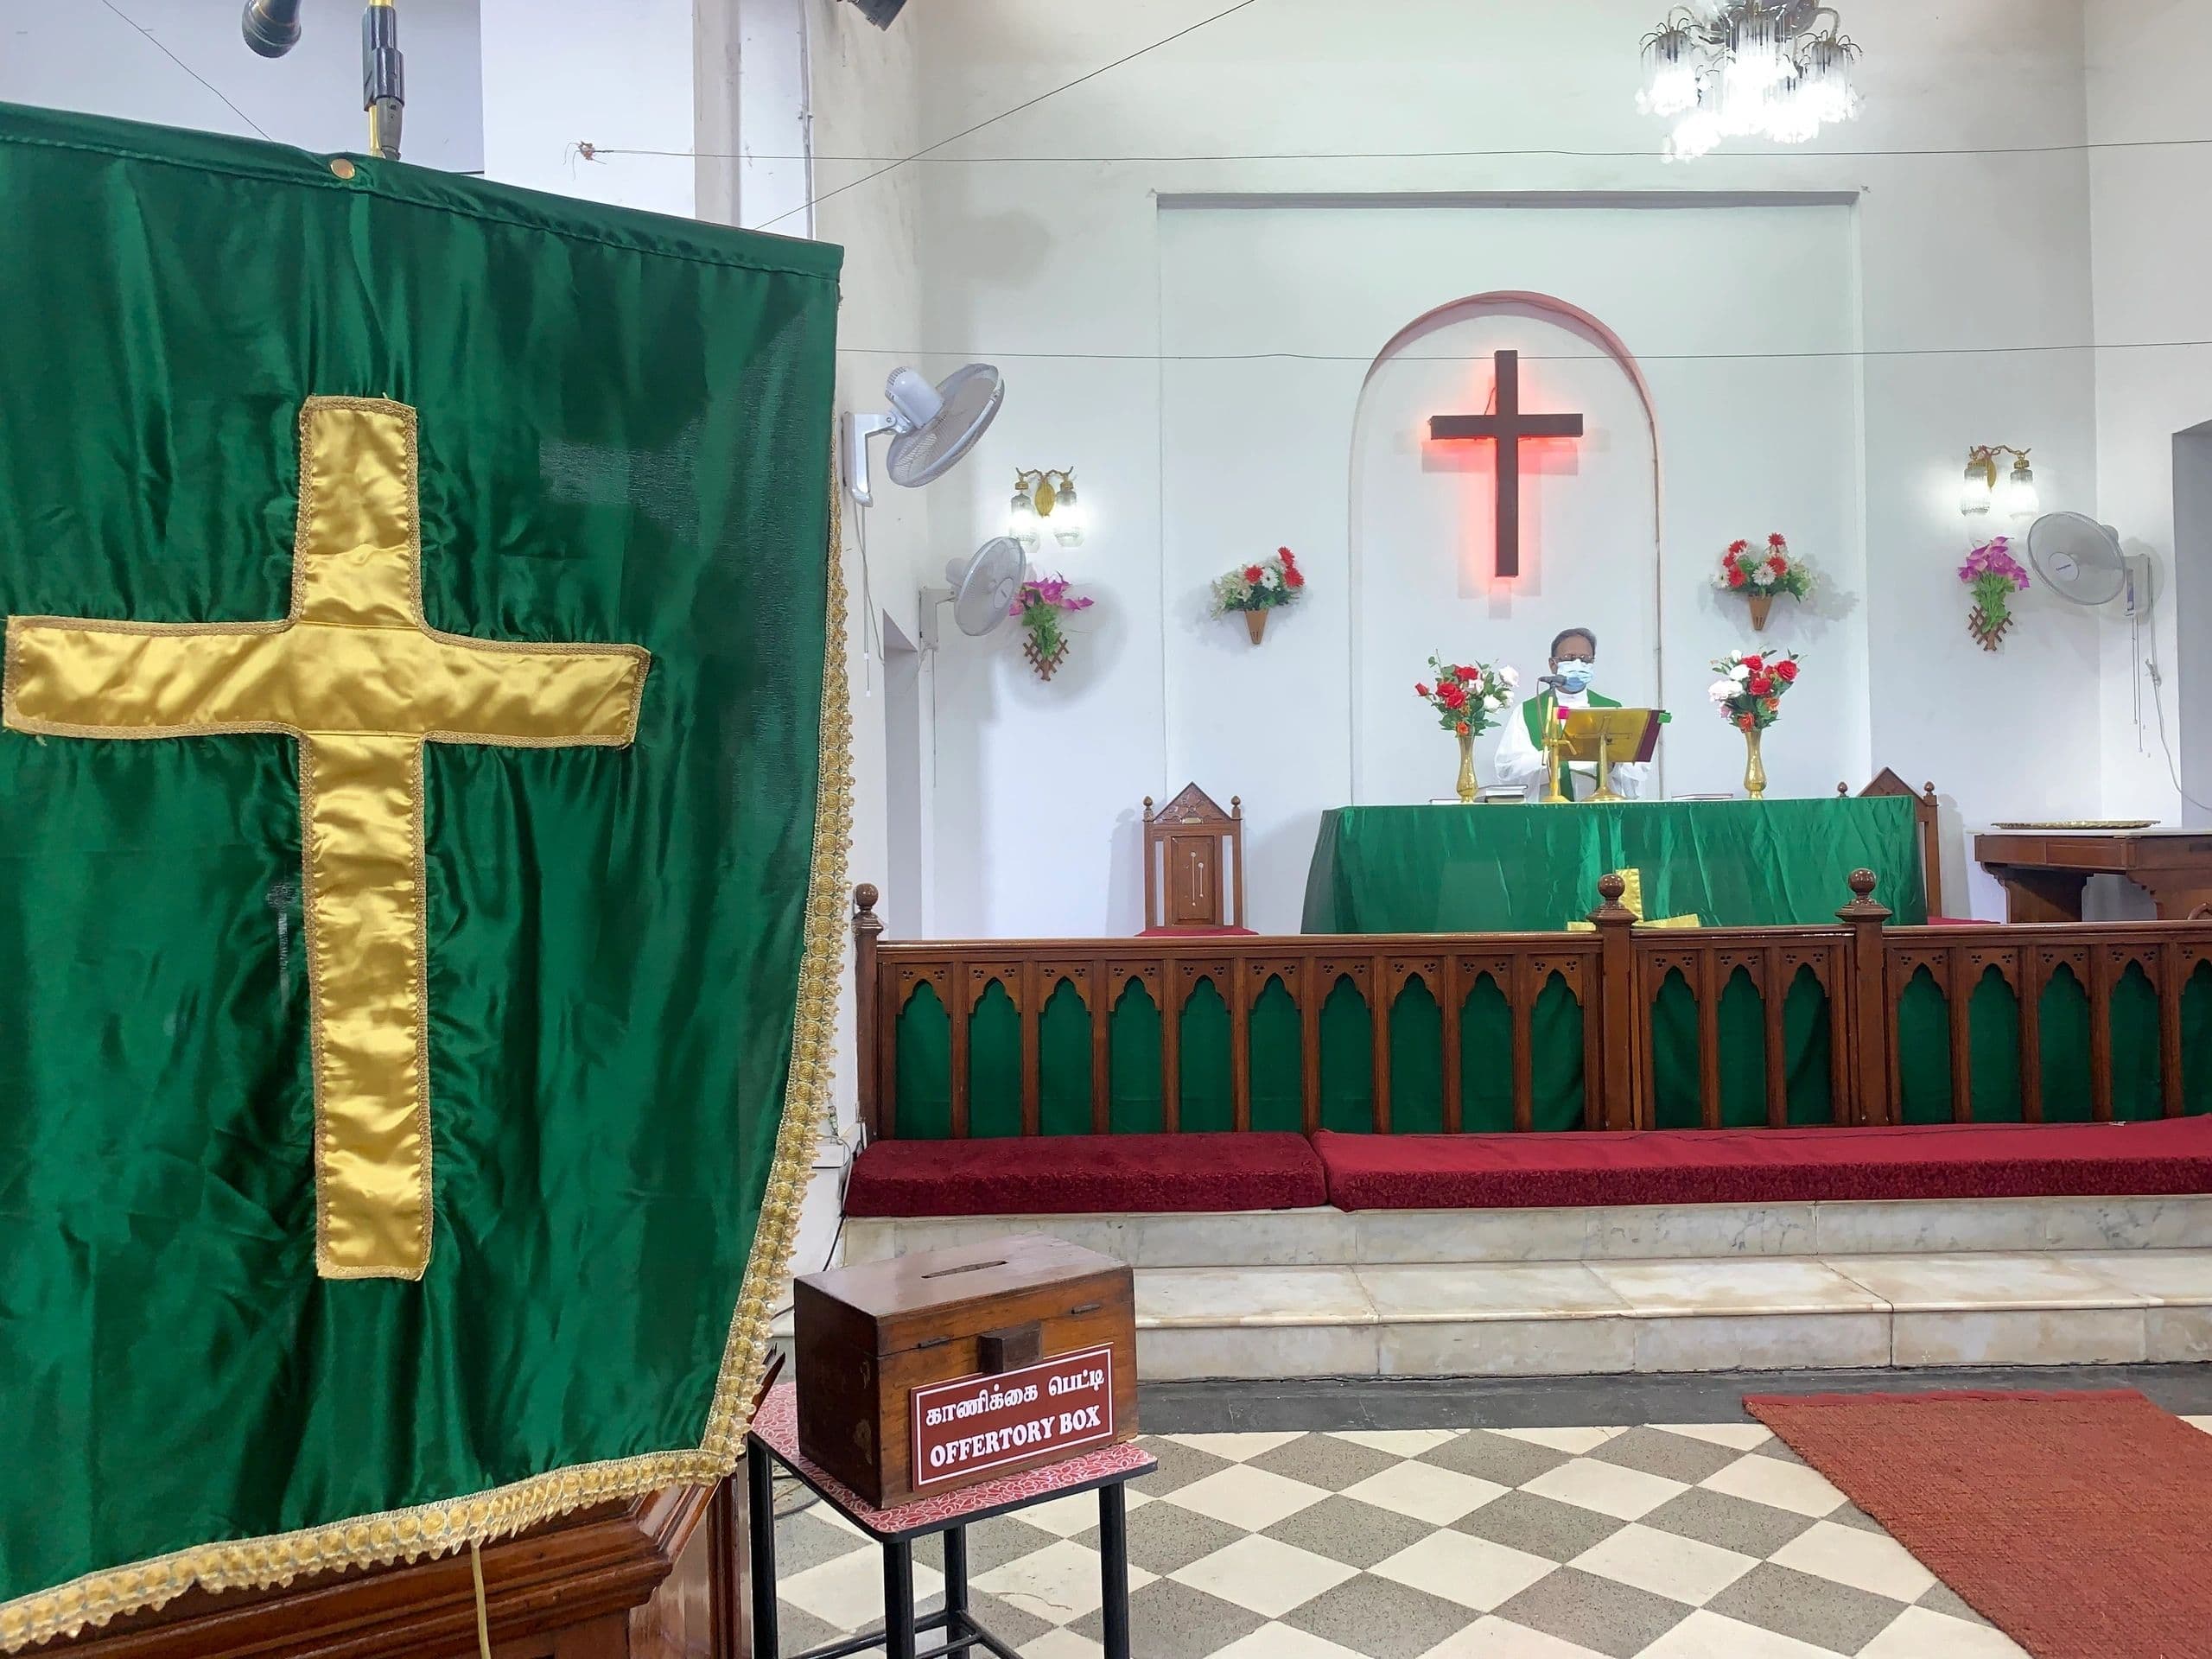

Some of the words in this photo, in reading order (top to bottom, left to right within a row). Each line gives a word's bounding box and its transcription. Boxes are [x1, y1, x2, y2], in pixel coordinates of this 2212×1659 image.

[925, 1383, 1039, 1427] காணிக்கை
[1048, 1369, 1105, 1396] பெட்டி
[930, 1415, 1056, 1467] OFFERTORY
[1058, 1405, 1101, 1435] BOX
